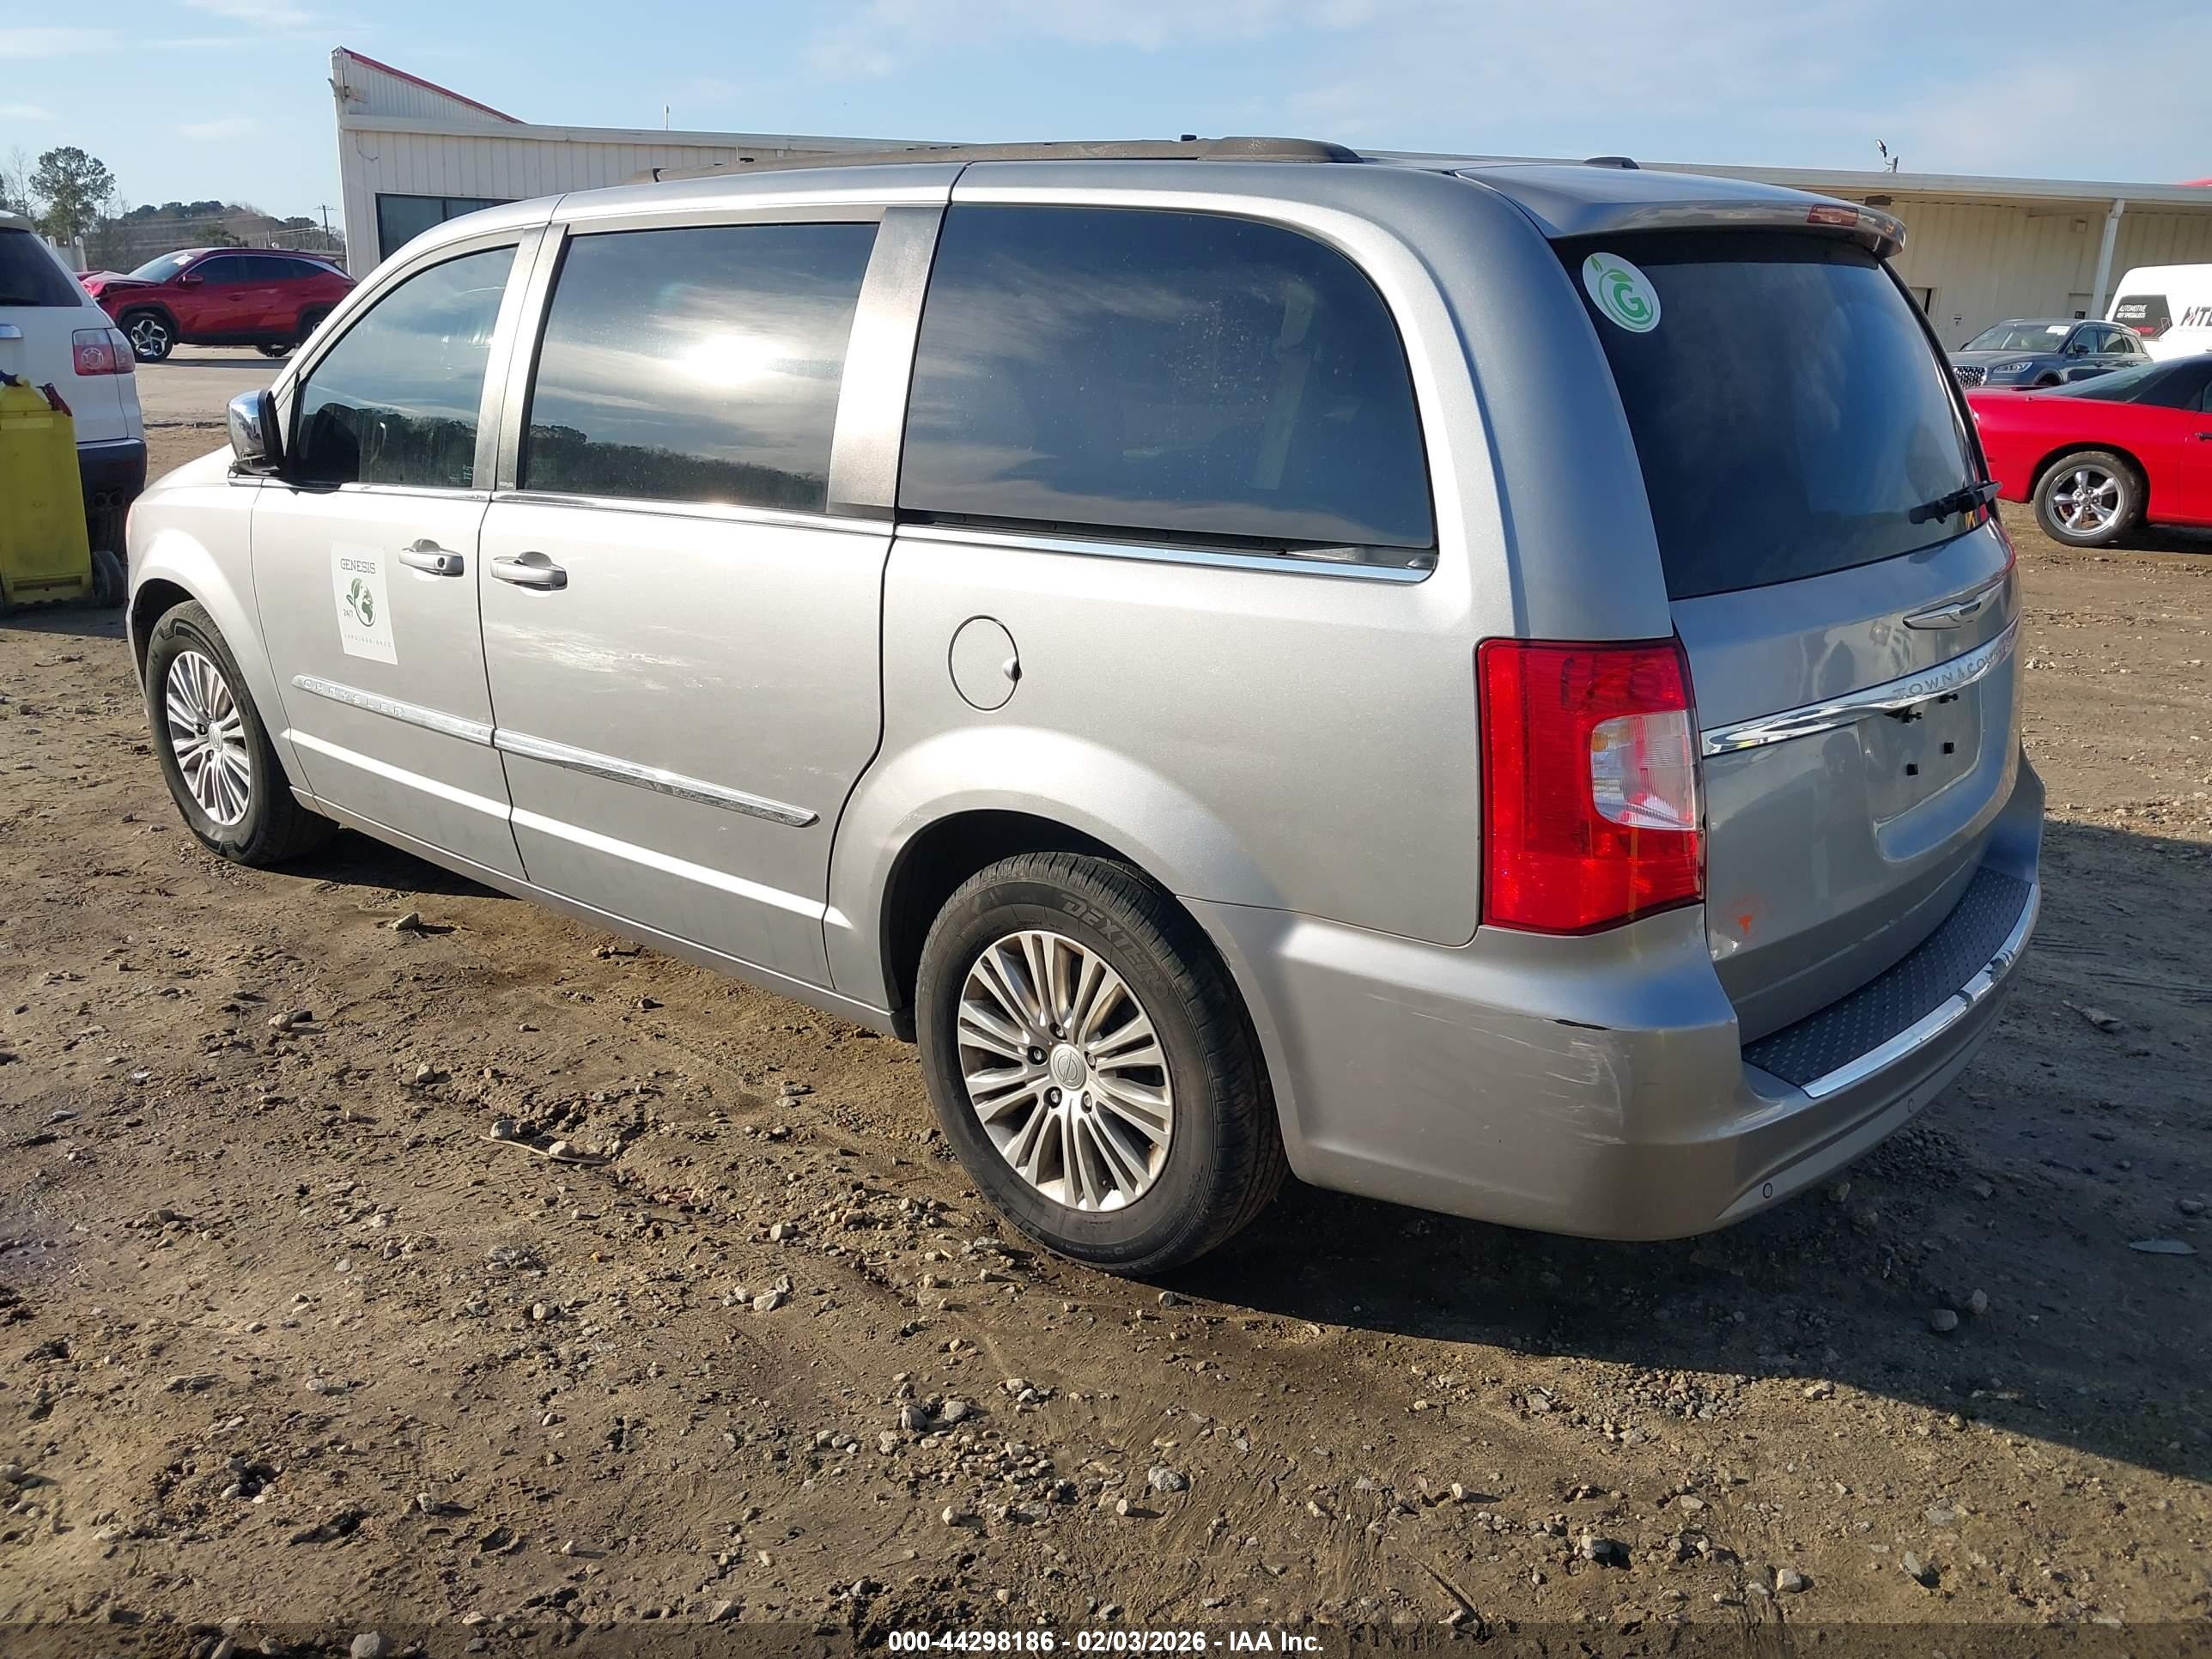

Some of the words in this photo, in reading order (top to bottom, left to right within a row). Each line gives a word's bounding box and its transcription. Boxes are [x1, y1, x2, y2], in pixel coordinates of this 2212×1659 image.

[1613, 283, 1650, 318] G
[340, 557, 376, 574] GENESIS
[303, 678, 404, 717] CHRYSLER
[1893, 672, 1954, 699] TOWN
[1958, 667, 1966, 680] &
